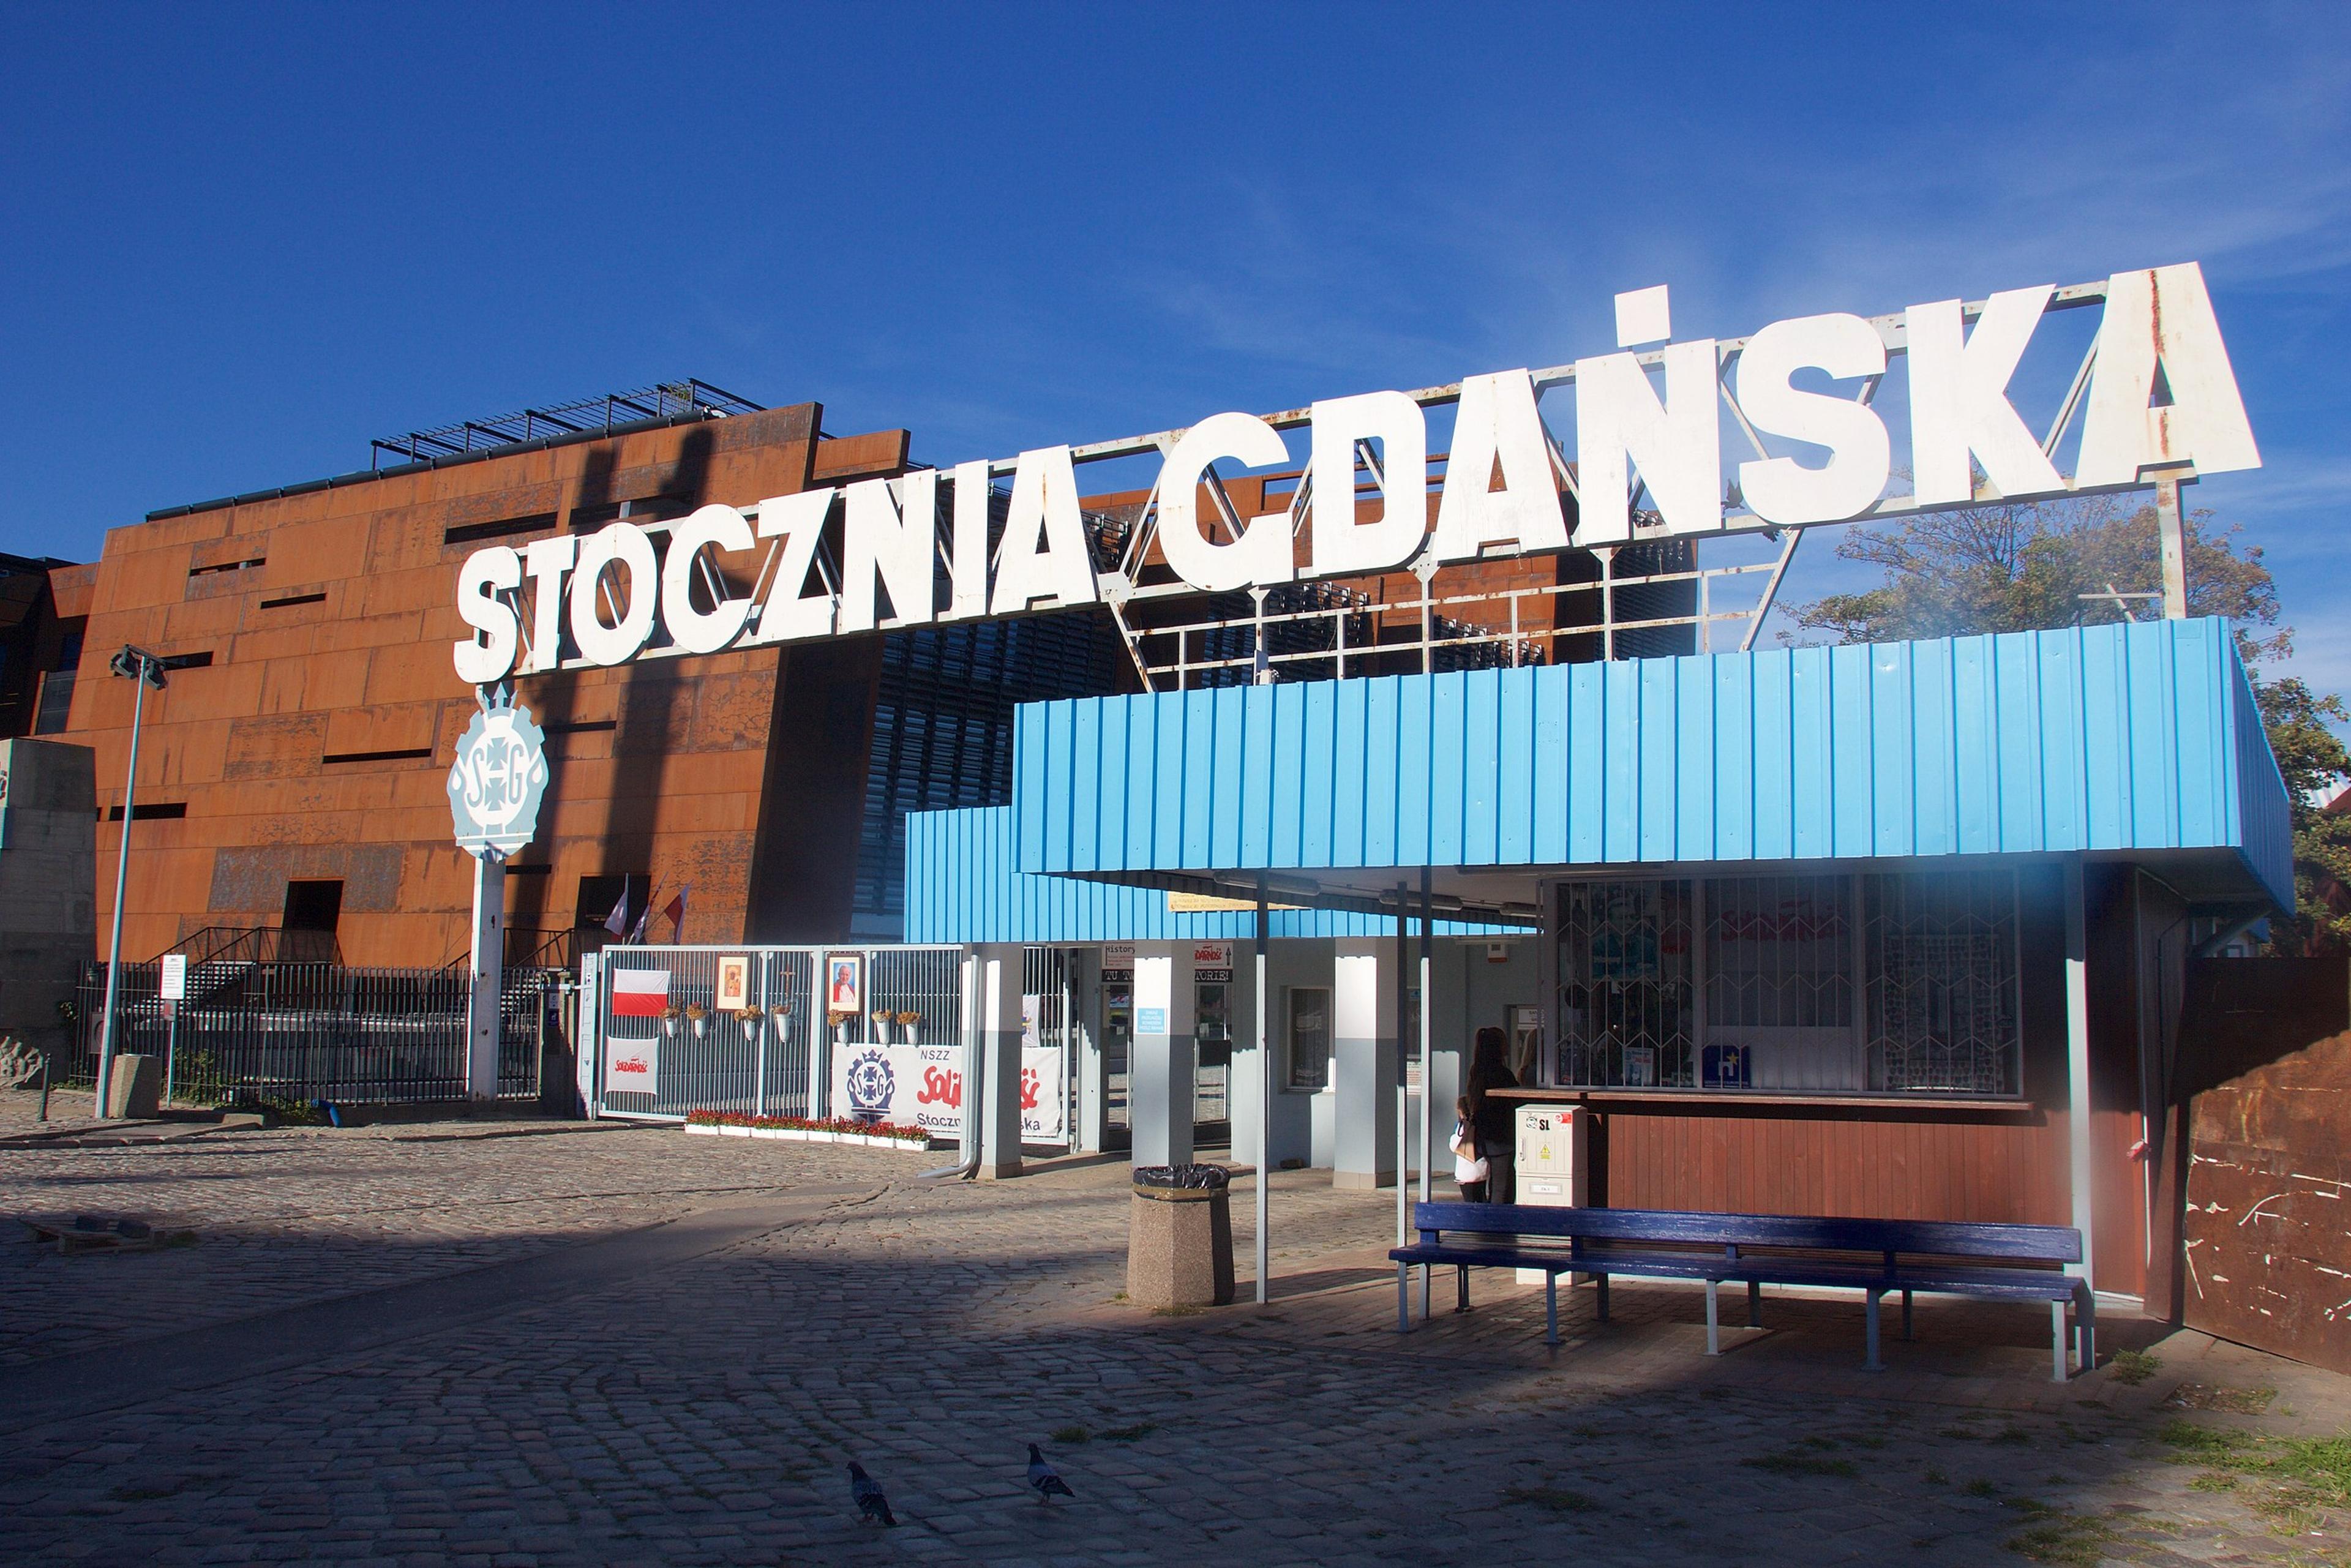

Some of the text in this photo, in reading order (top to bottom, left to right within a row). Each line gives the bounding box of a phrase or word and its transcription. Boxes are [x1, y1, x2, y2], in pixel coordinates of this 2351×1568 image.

[453, 445, 1100, 683] STOCZNIA
[1105, 945, 1135, 954] History
[1106, 970, 1118, 980] TU
[920, 1050, 950, 1060] NSZZ
